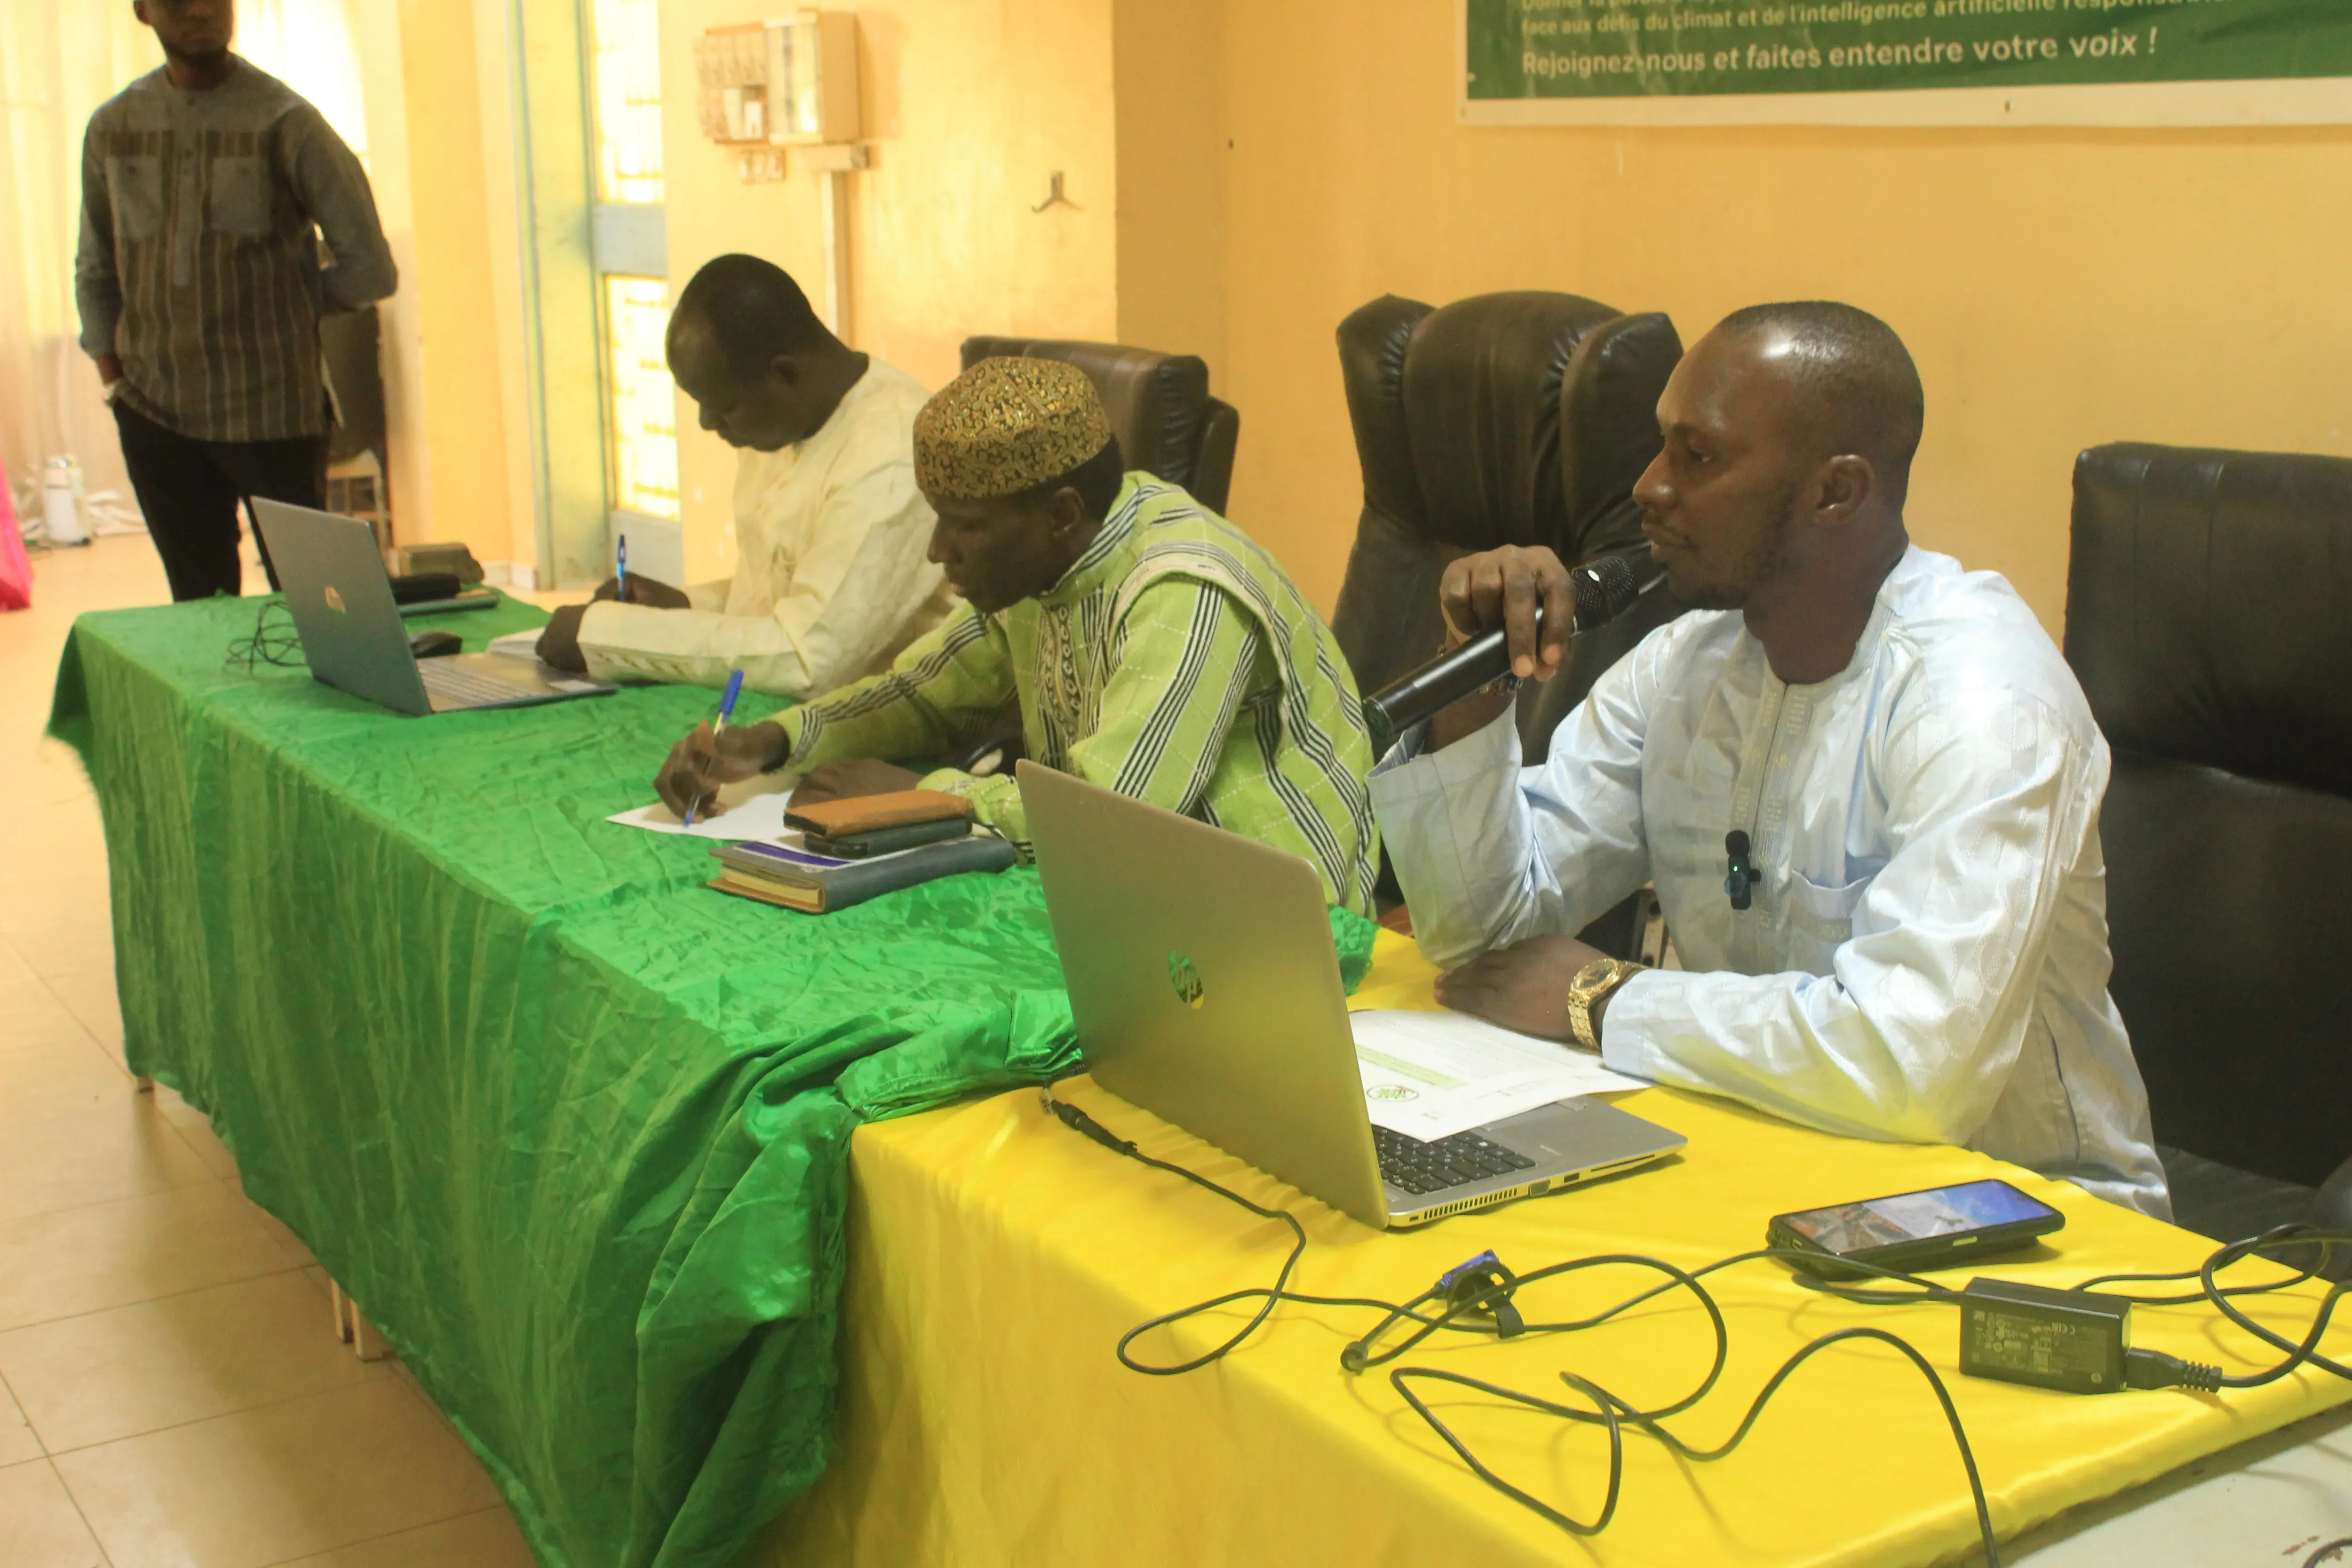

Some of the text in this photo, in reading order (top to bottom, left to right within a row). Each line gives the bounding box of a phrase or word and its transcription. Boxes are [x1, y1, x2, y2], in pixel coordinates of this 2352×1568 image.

[1522, 19, 1557, 35] face
[1561, 20, 1591, 34] aux
[1598, 13, 1640, 32] défis
[1645, 13, 1669, 31] du
[1673, 9, 1732, 29] climat
[1737, 8, 1757, 27] et
[1763, 7, 1786, 25] de
[1790, 1, 1927, 25] l'intelligence
[1523, 51, 1706, 79] Rejoignez-nous
[1713, 47, 1739, 71] et
[1747, 43, 1822, 70] faites
[1829, 37, 1963, 66] entendre
[1973, 34, 2058, 61] votre
[2068, 26, 2138, 58] voix
